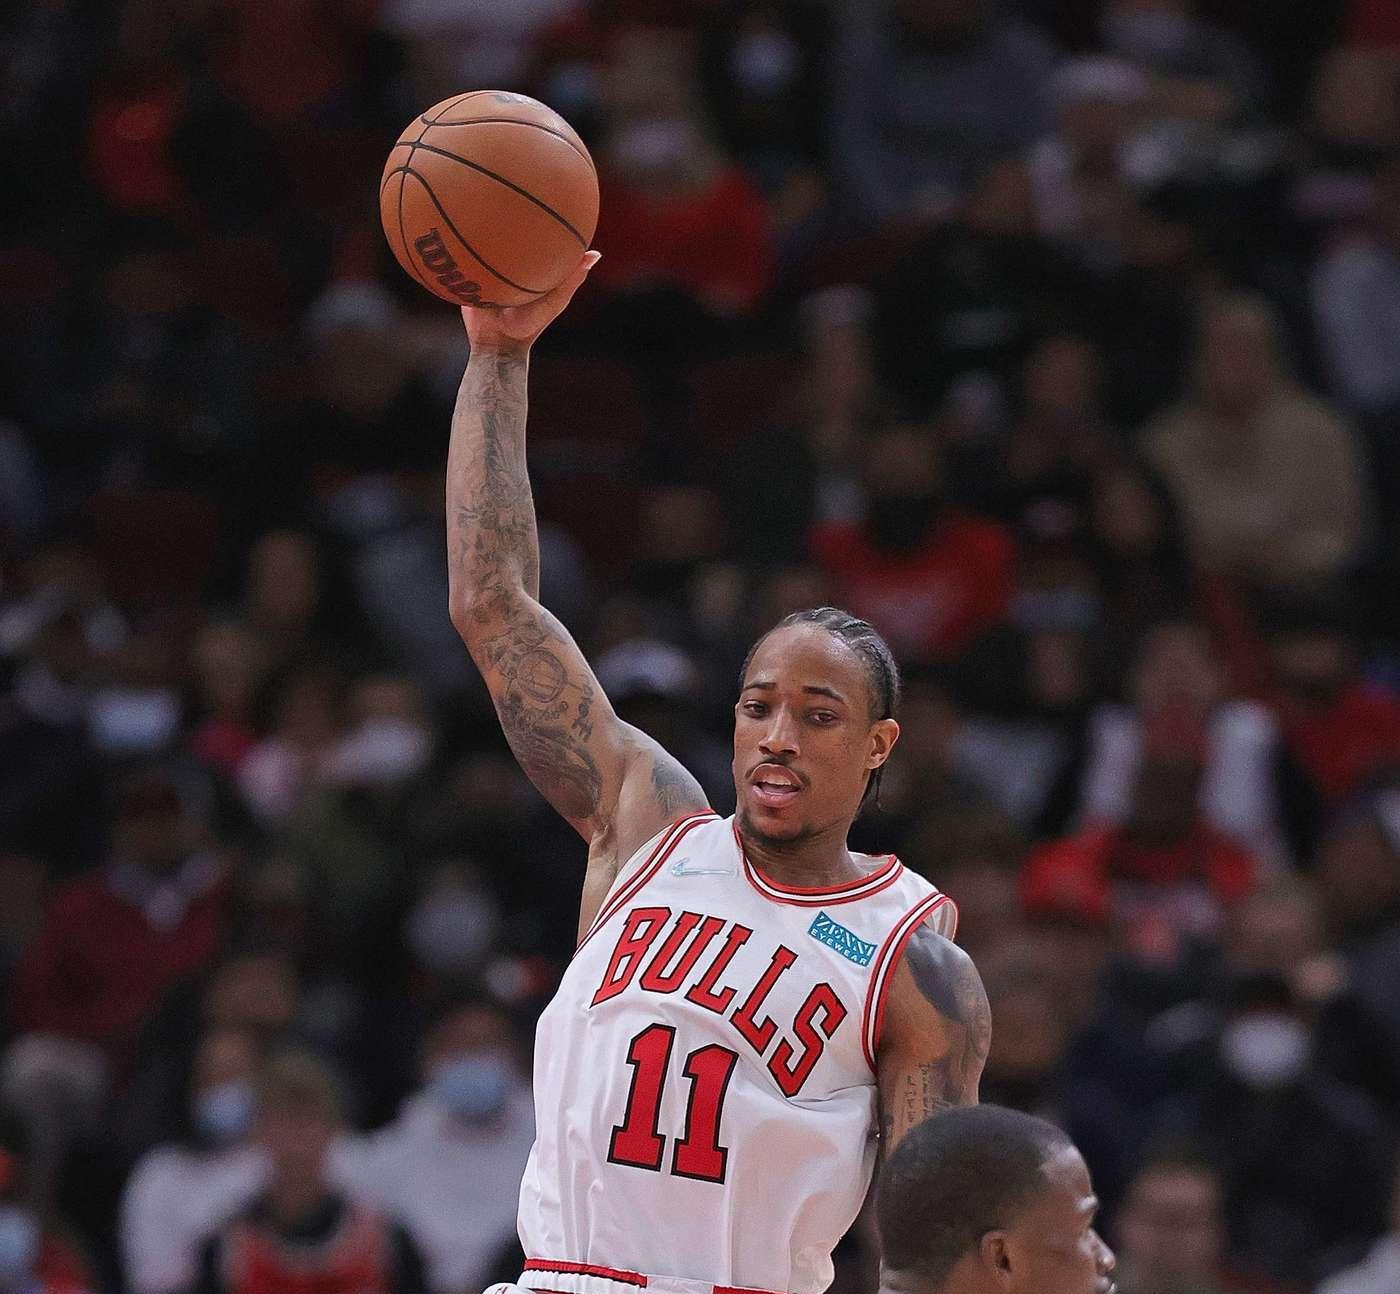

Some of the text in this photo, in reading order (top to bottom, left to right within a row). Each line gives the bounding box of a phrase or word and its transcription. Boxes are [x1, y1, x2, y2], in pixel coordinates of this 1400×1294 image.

[589, 906, 848, 1098] BULLS
[810, 928, 868, 966] EYEWEAR
[606, 1022, 740, 1185] 11
